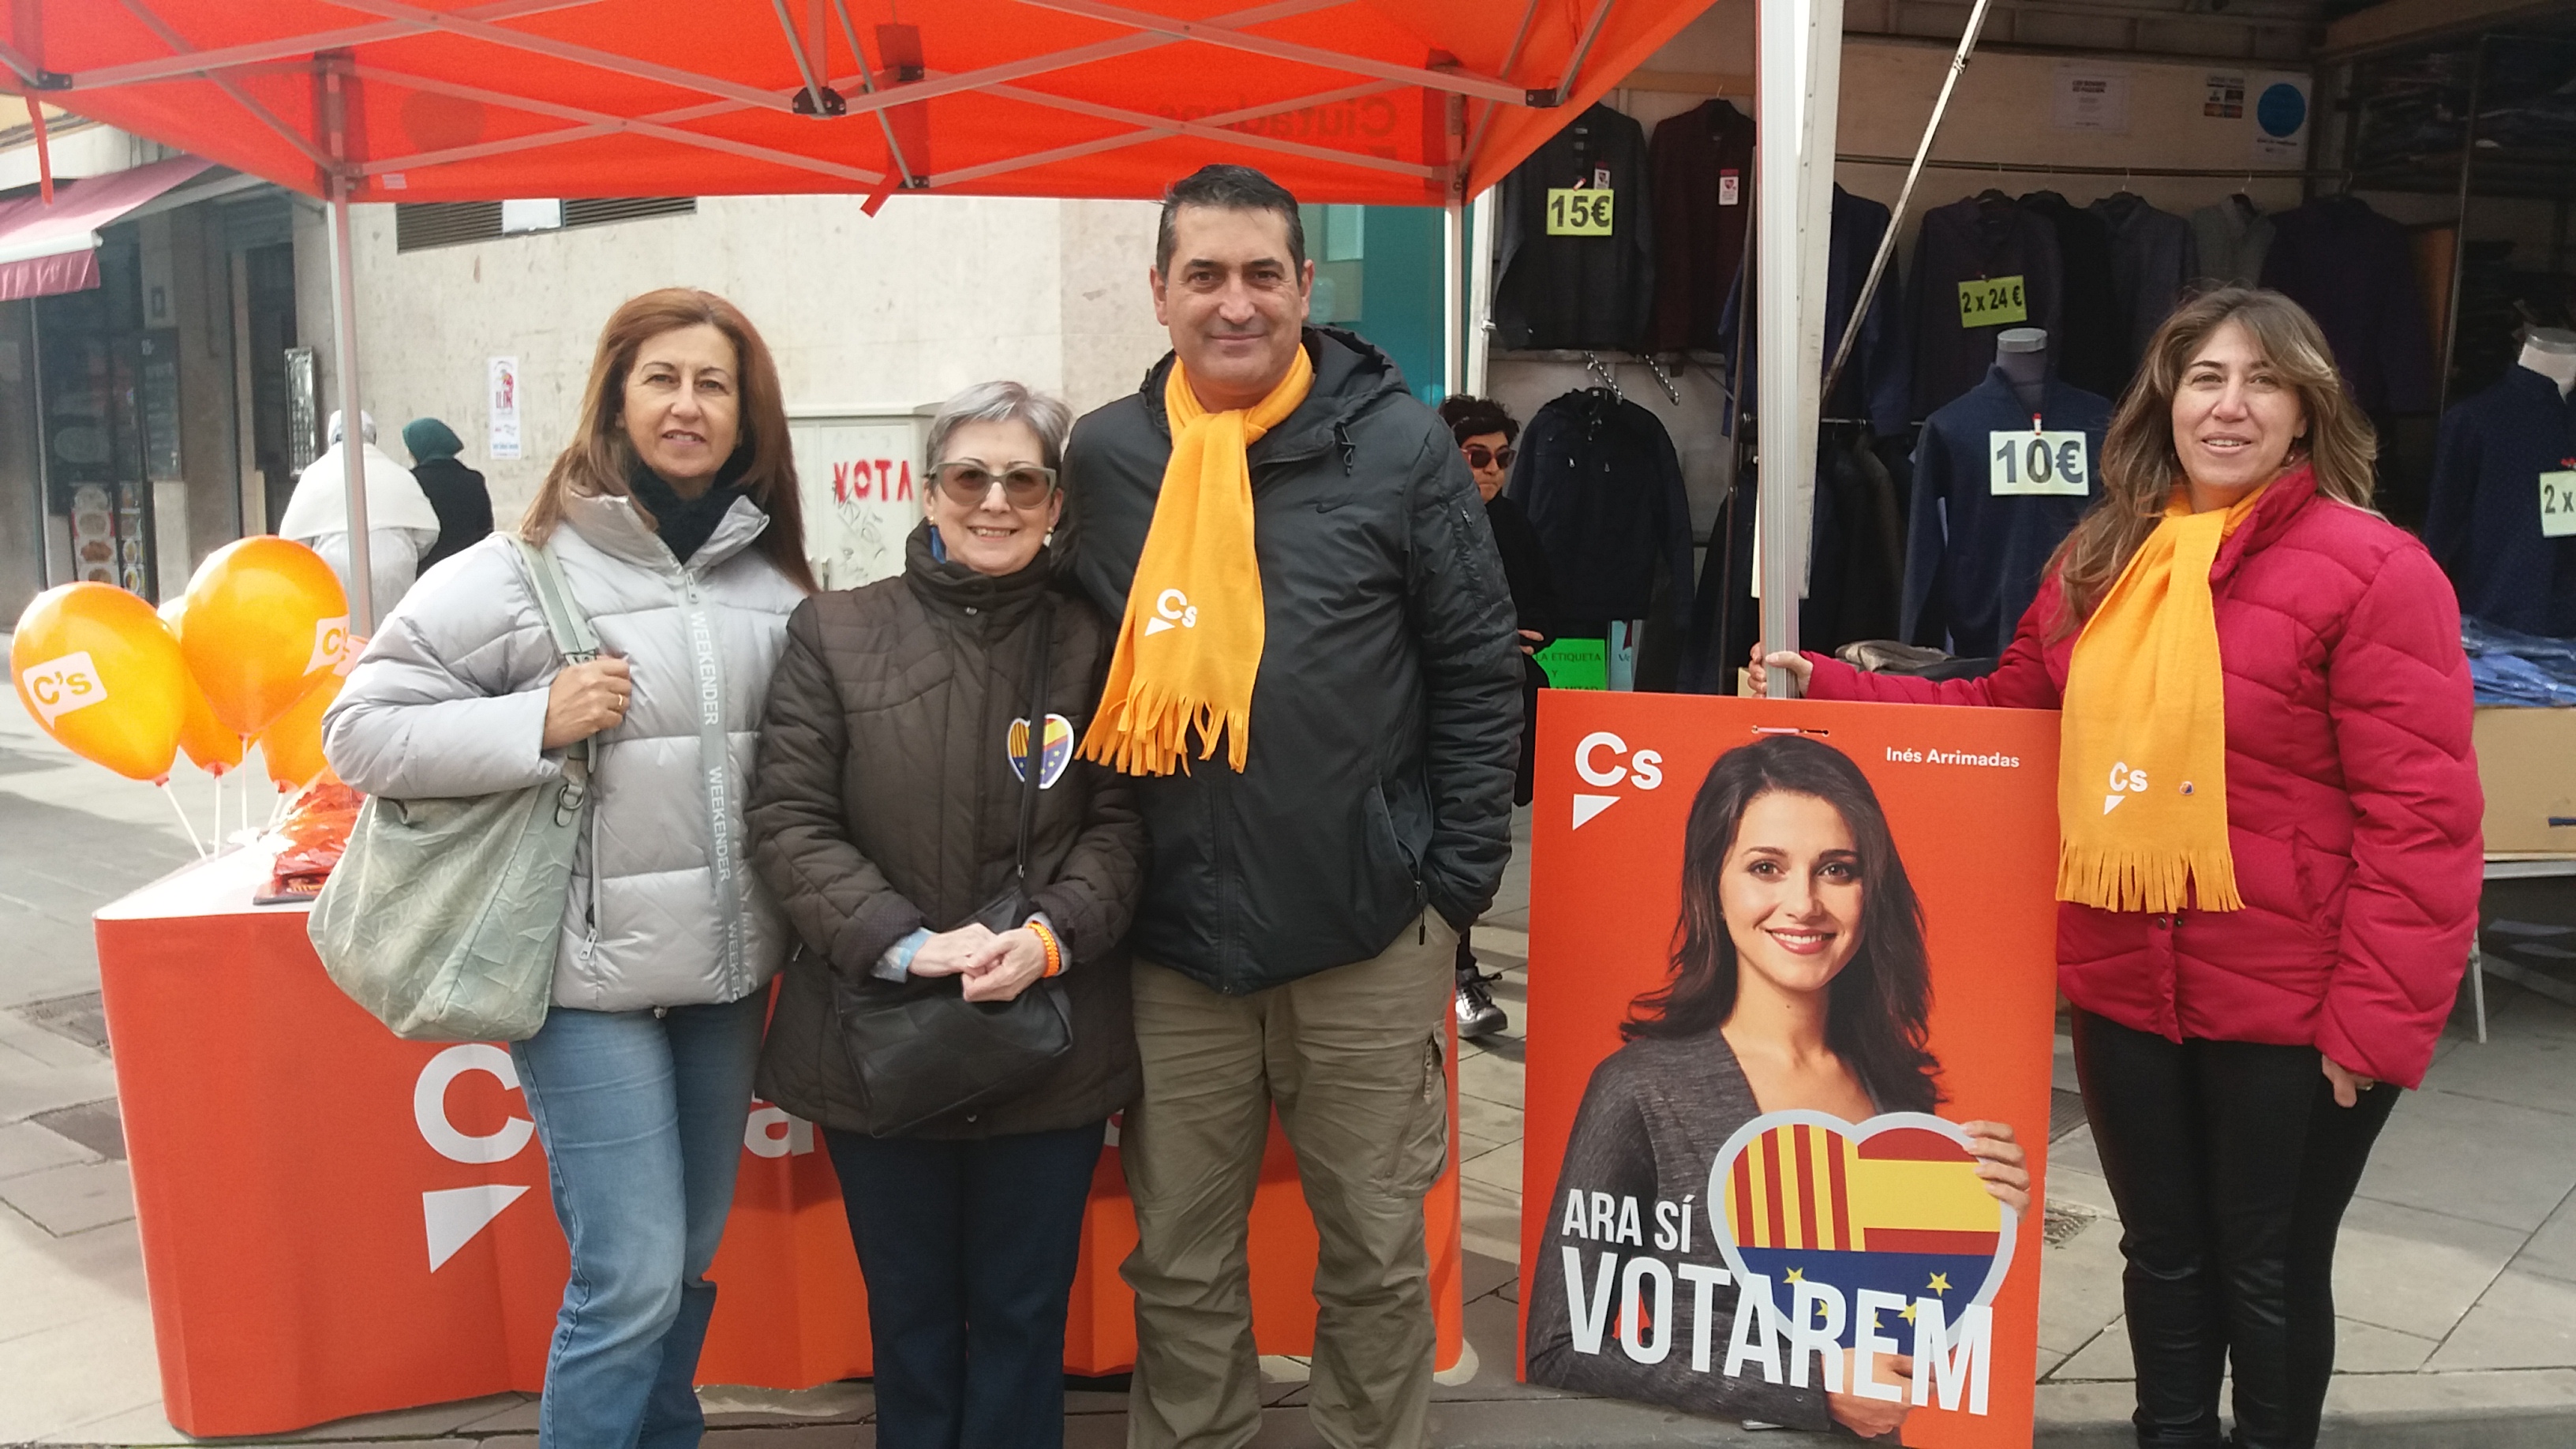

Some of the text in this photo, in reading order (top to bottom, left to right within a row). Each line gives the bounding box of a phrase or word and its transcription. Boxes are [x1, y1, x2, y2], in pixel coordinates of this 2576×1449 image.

[1551, 195, 1611, 227] 15€
[1962, 285, 2022, 313] 2 x 24 €
[1997, 439, 2084, 484] 10€
[833, 459, 914, 503] VOTA
[2544, 483, 2574, 514] 2 x
[1156, 589, 1198, 628] Cs
[690, 610, 719, 725] WEEKENDER
[1551, 653, 1601, 663] ETIQUETA
[1552, 669, 1559, 678] Y
[33, 670, 93, 706] C's
[1574, 732, 1663, 790] Cs
[1886, 746, 2020, 768] Inés Arrimadas
[2110, 762, 2148, 792] Cs
[709, 766, 731, 882] WEEKENDER
[1562, 1189, 1696, 1253] ARA SÍ
[1562, 1245, 1994, 1417] VOTAREM
